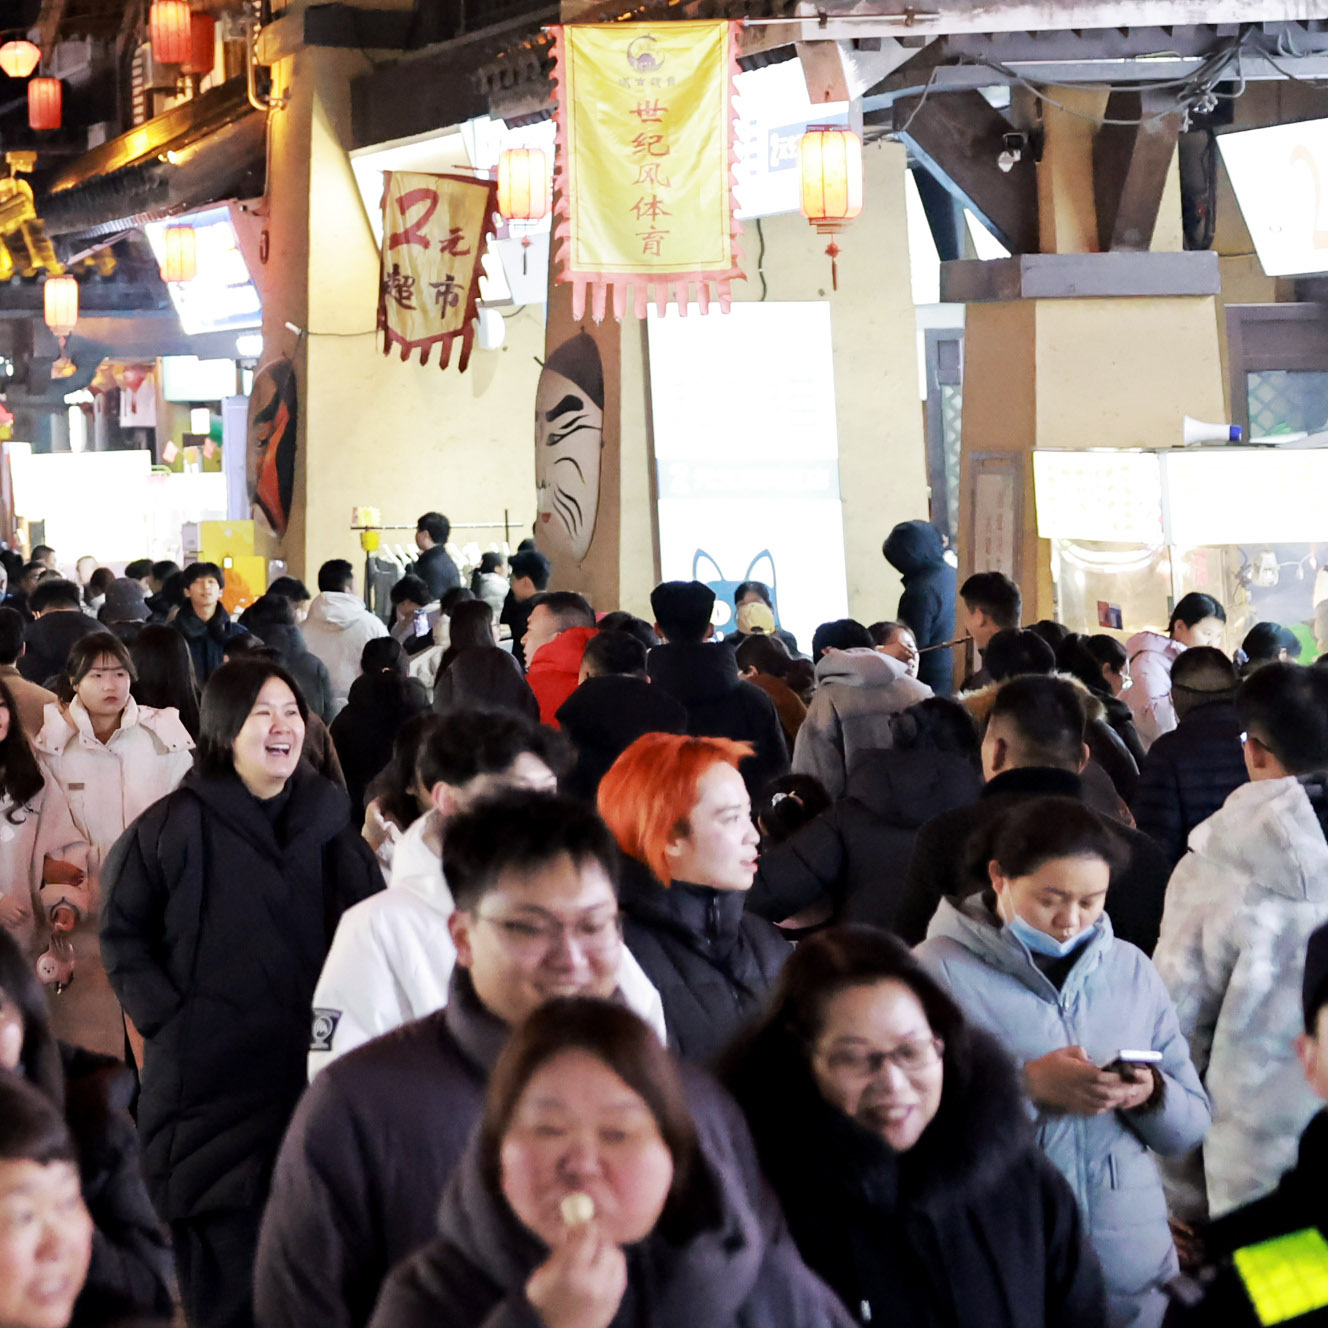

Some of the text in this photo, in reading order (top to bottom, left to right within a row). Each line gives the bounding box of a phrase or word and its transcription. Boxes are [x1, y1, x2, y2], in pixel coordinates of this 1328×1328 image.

[629, 101, 672, 257] 世纪风体育
[389, 188, 471, 257] 2元
[382, 264, 465, 320] 超市
